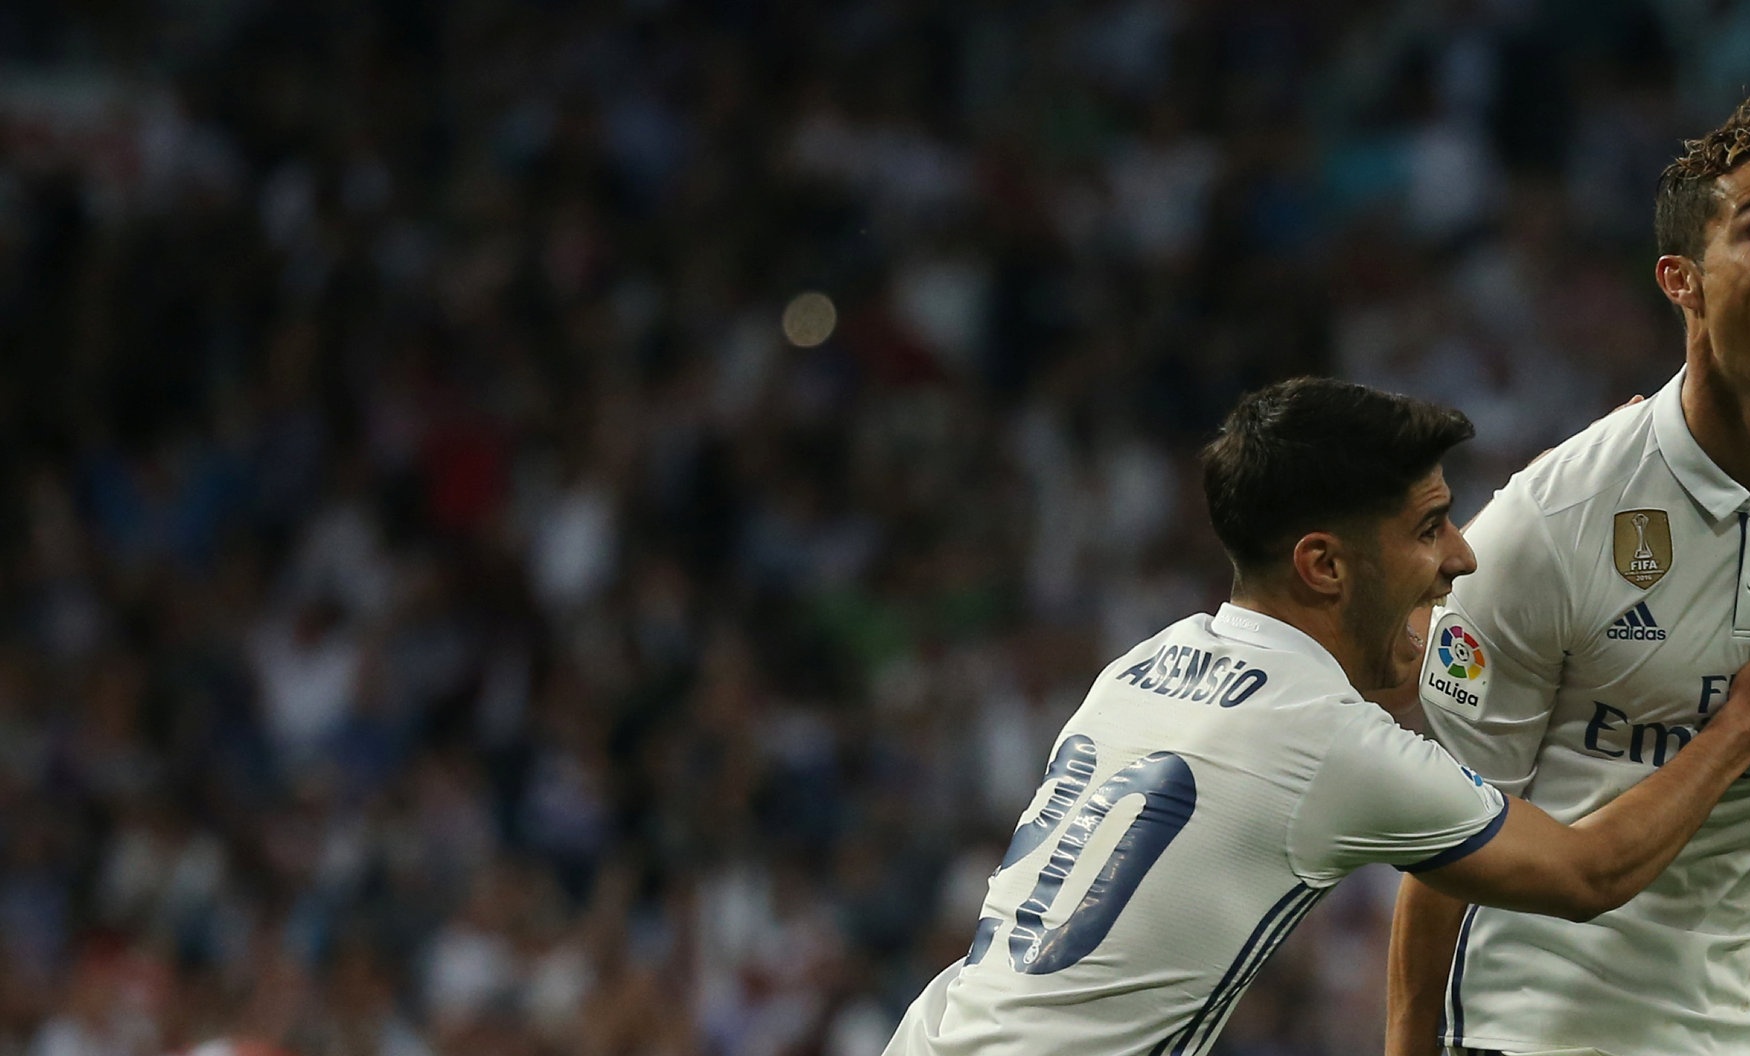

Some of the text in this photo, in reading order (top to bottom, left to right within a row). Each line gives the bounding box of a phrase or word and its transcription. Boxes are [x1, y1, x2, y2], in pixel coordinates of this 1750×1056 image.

[1630, 560, 1658, 571] FIFA
[1606, 625, 1667, 641] adidas
[1428, 672, 1479, 707] LaLiga
[963, 733, 1198, 976] 20
